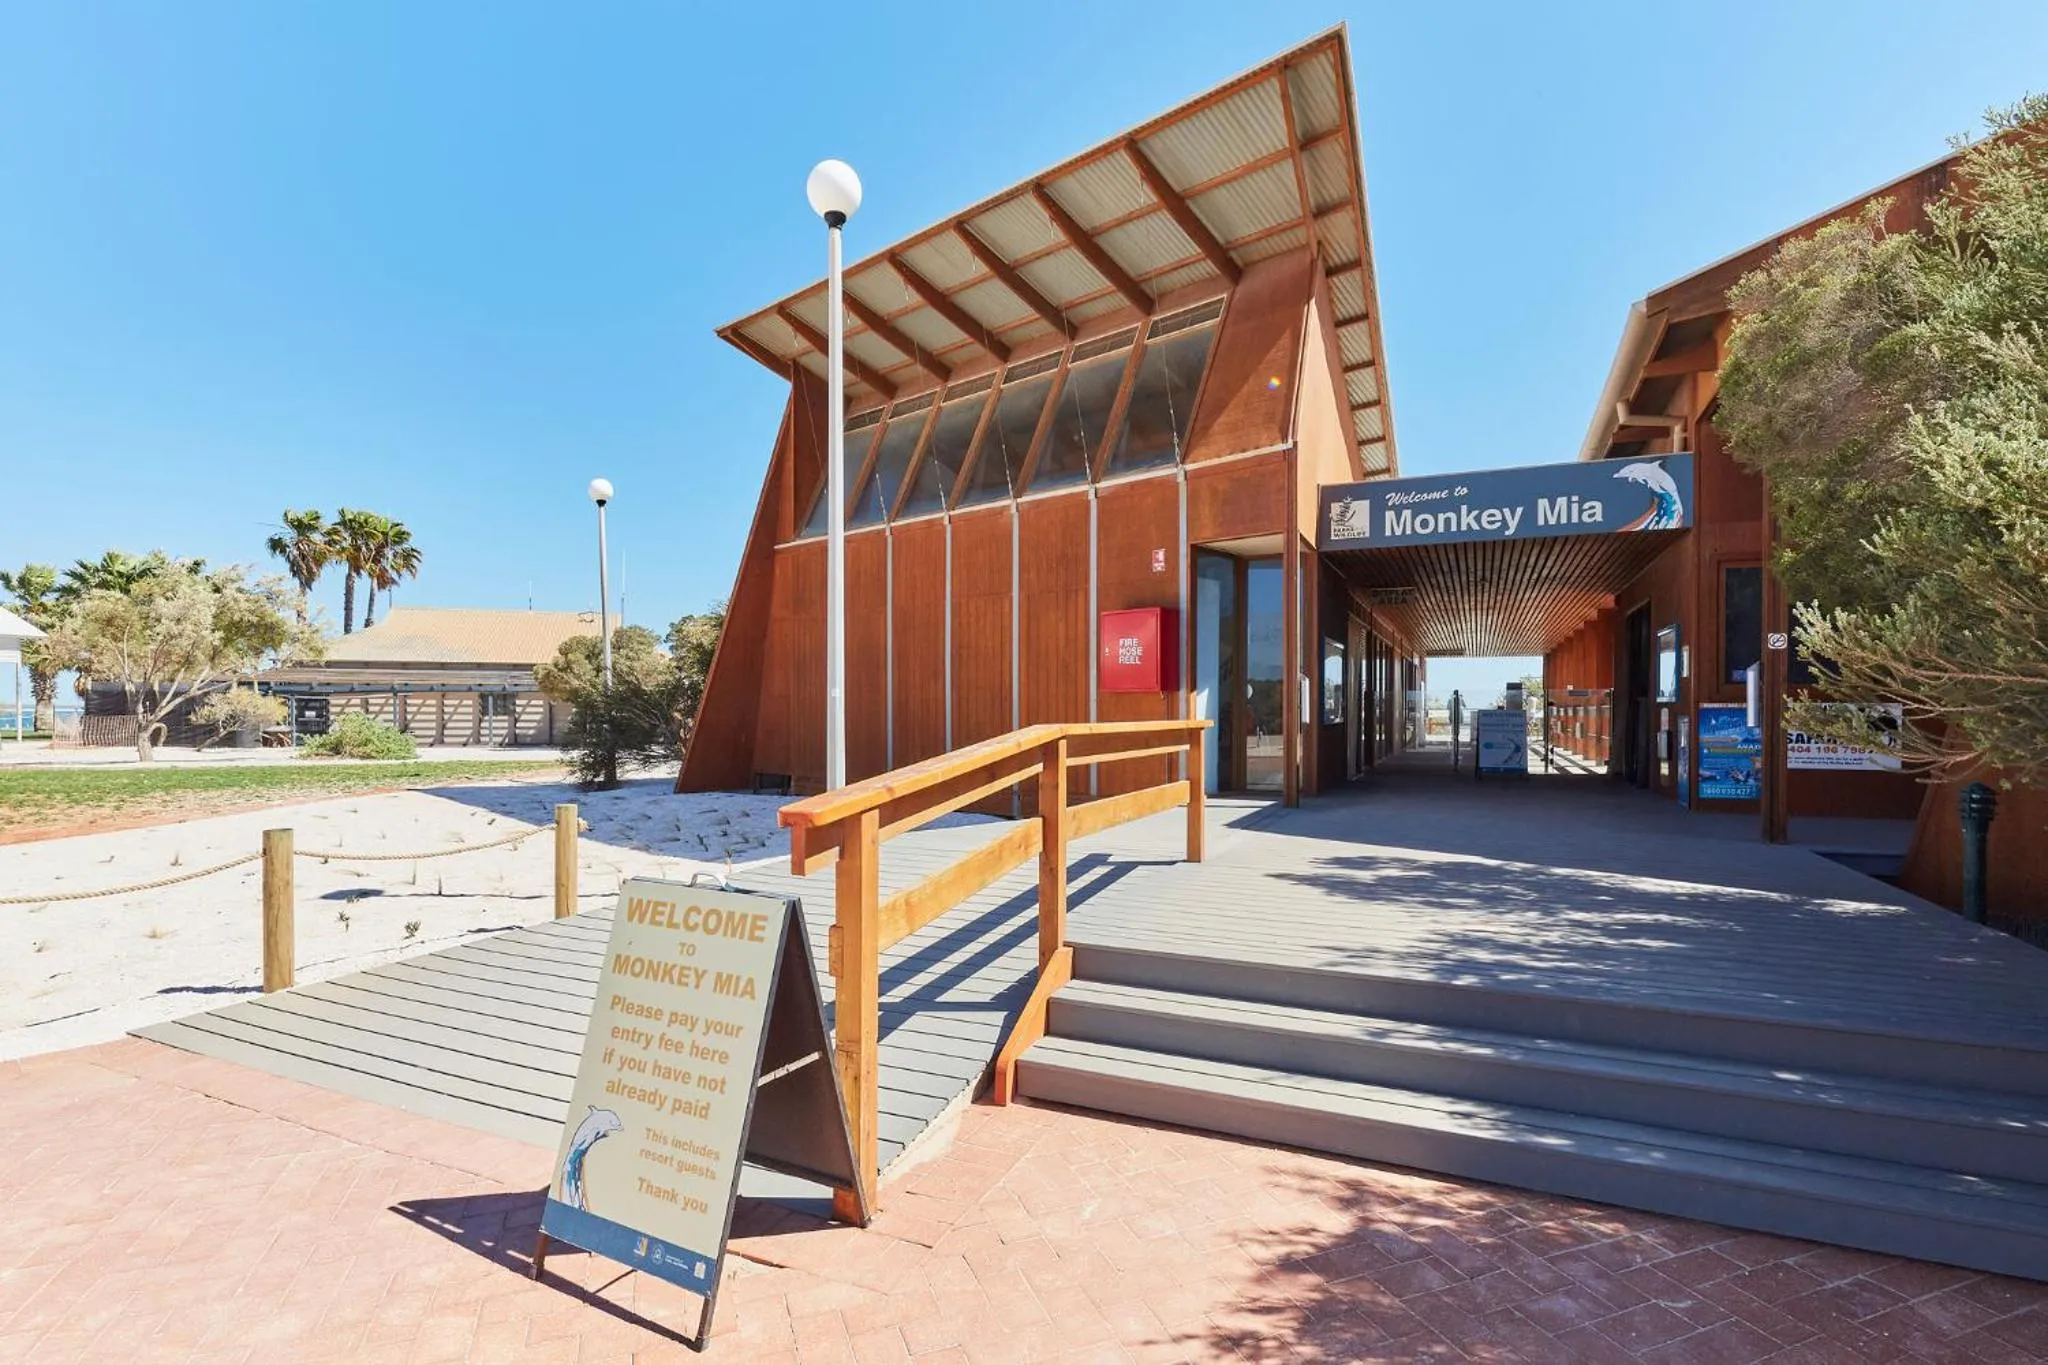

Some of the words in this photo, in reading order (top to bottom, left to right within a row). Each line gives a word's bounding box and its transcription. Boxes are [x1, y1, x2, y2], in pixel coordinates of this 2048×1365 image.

[1385, 504, 1524, 536] Monkey
[1537, 495, 1604, 526] Mia
[1386, 490, 1449, 506] Welcome
[1453, 486, 1468, 497] to
[1118, 655, 1142, 665] REEL
[1119, 638, 1140, 647] FIRE
[1119, 646, 1144, 656] HOSE
[626, 897, 769, 943] WELCOME
[678, 942, 697, 957] TO
[612, 954, 708, 990] MONKEY
[712, 971, 756, 1000] MIA
[610, 994, 664, 1021] Please
[667, 1010, 700, 1033] pay
[702, 1018, 743, 1039] your
[611, 1025, 654, 1050] entry
[658, 1031, 685, 1054] fee
[689, 1040, 730, 1064] here
[602, 1046, 616, 1065] if
[617, 1054, 648, 1073] you
[651, 1058, 692, 1085] have
[697, 1073, 727, 1095] not
[605, 1078, 668, 1112] already
[670, 1097, 711, 1121] paid
[645, 1126, 669, 1146] This
[670, 1135, 721, 1161] includes
[639, 1148, 674, 1168] resort
[675, 1159, 717, 1180] guests
[637, 1176, 679, 1205] Thank
[681, 1194, 709, 1215] you
